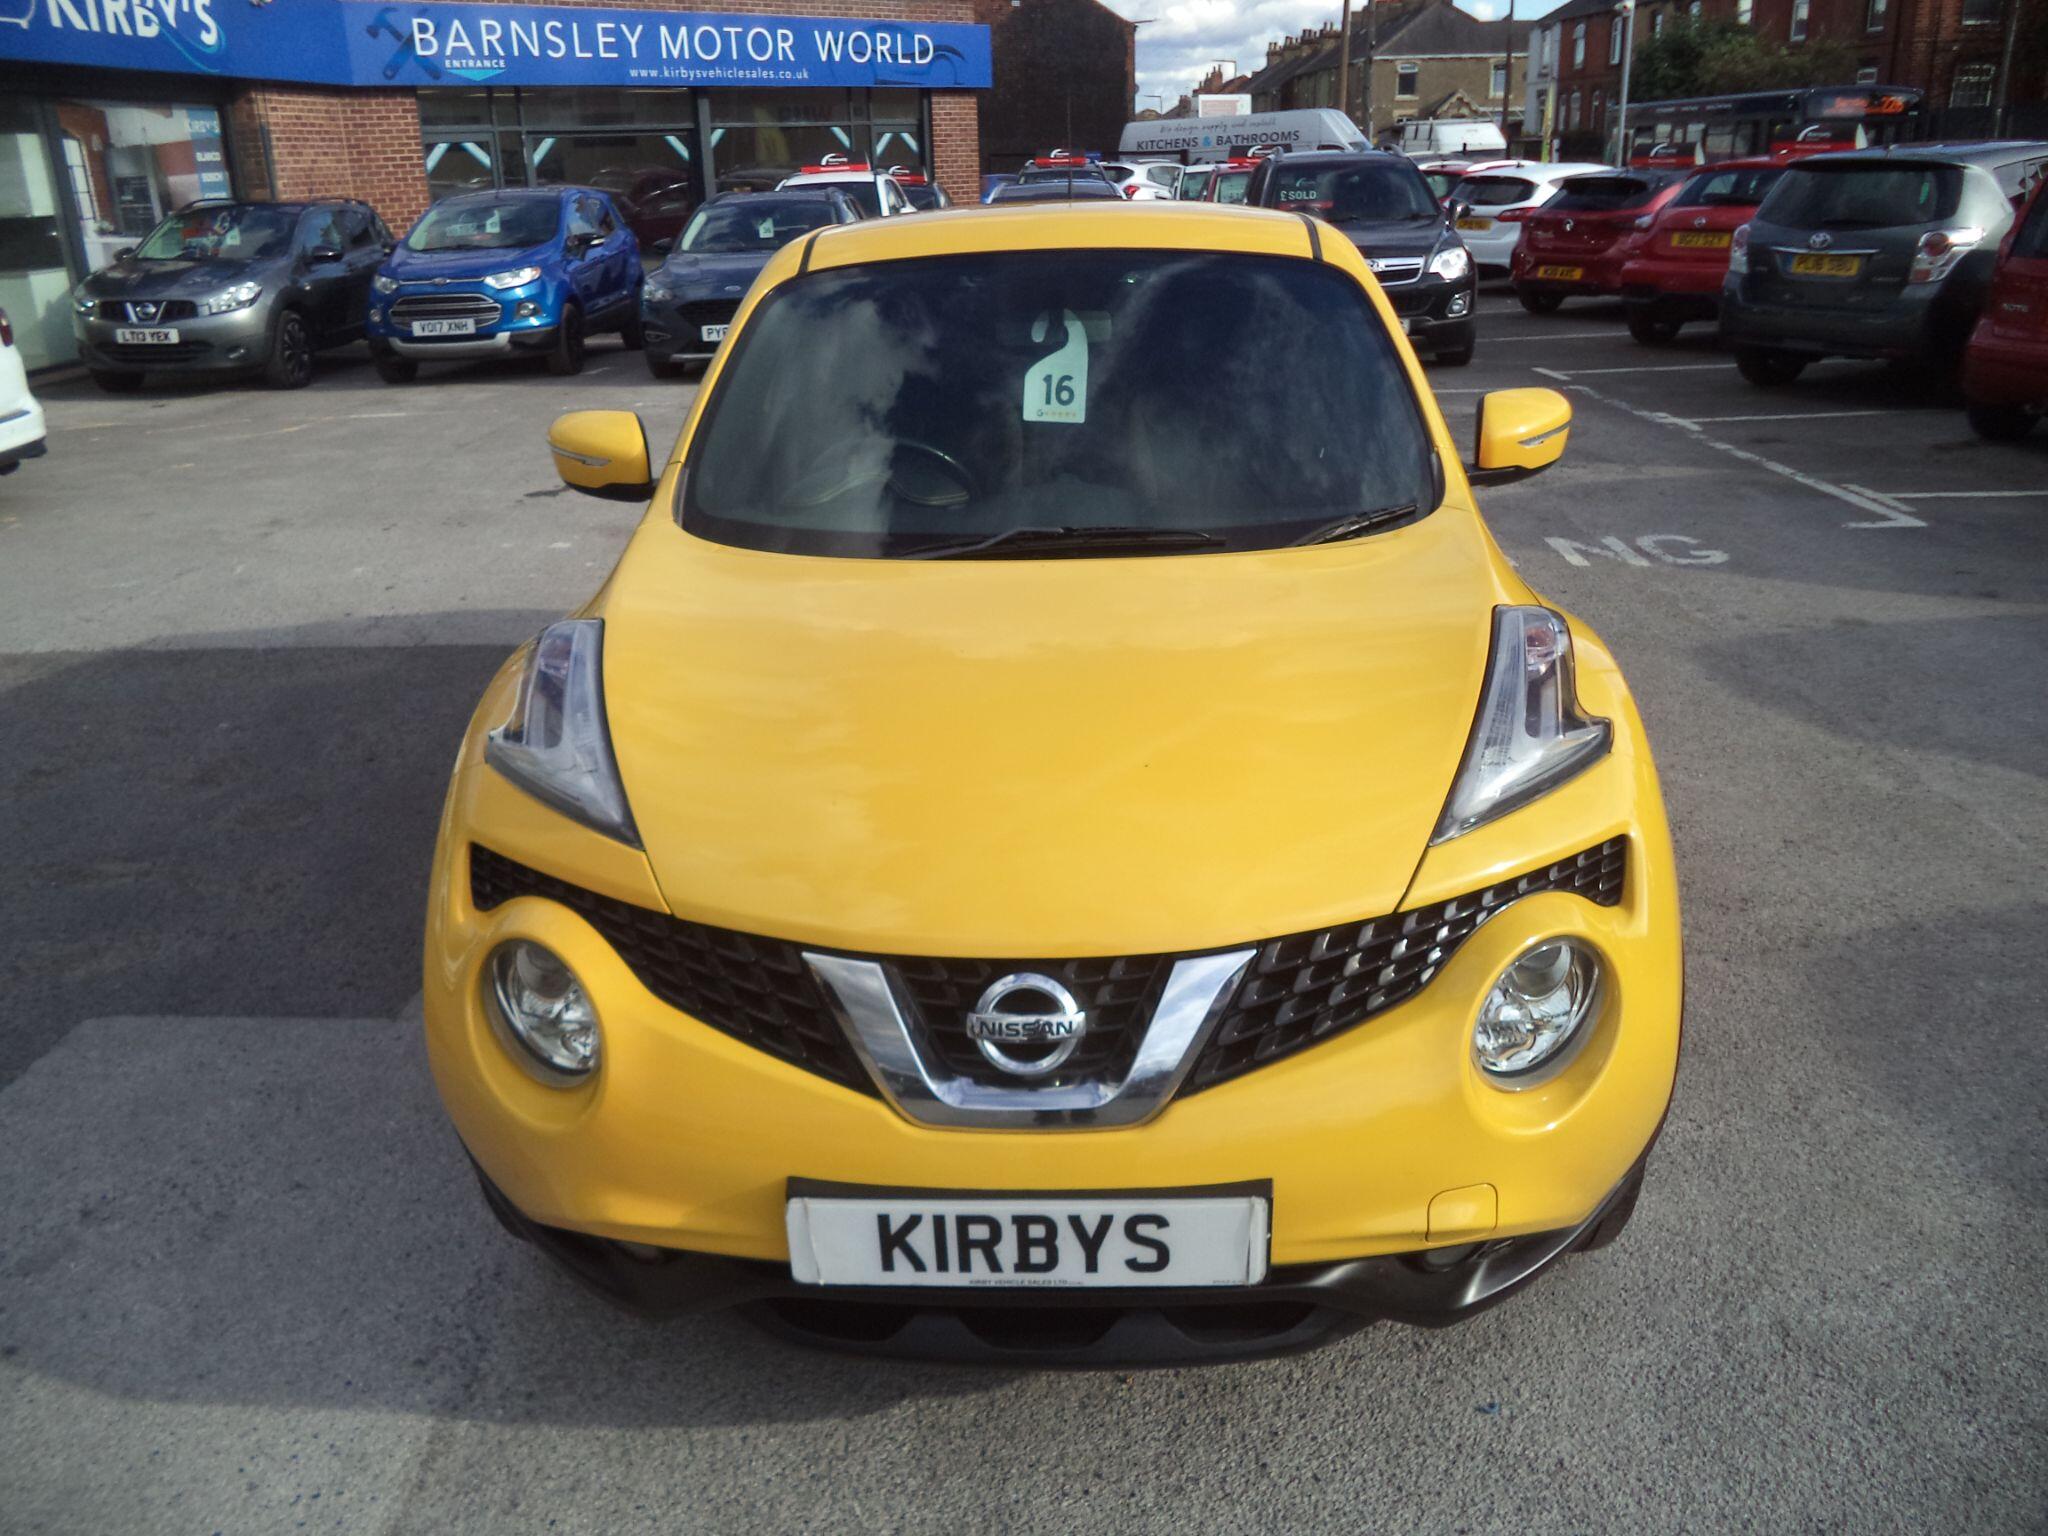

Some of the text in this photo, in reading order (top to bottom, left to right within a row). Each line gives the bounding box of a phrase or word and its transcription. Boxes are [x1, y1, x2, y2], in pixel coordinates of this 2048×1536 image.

[411, 17, 934, 64] BARNSLEY MOTOR WORLD
[444, 59, 507, 69] ENTRANCE
[628, 66, 809, 81] www.kirbysvehiclesales.co.uk
[1136, 136, 1199, 151] KITCHENS
[1216, 130, 1300, 147] BATHROOMS
[1042, 374, 1075, 407] 16
[979, 1020, 1073, 1038] NISSAN
[876, 1213, 1171, 1274] KIRBYS
